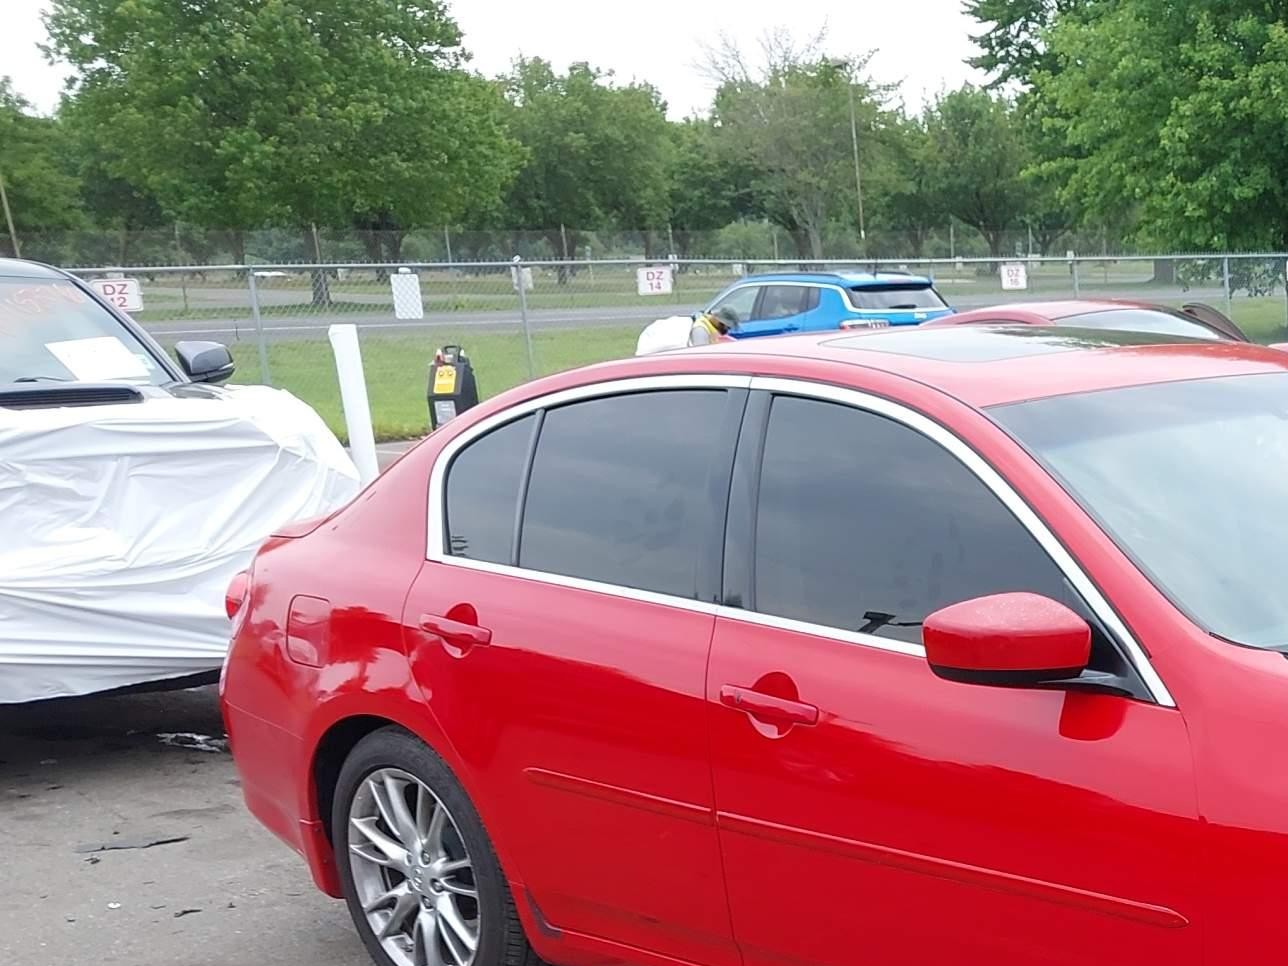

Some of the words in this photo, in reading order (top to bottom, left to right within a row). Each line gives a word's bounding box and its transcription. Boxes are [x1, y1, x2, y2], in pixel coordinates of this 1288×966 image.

[646, 271, 664, 281] DZ
[102, 283, 128, 295] DZ
[648, 281, 662, 291] 14
